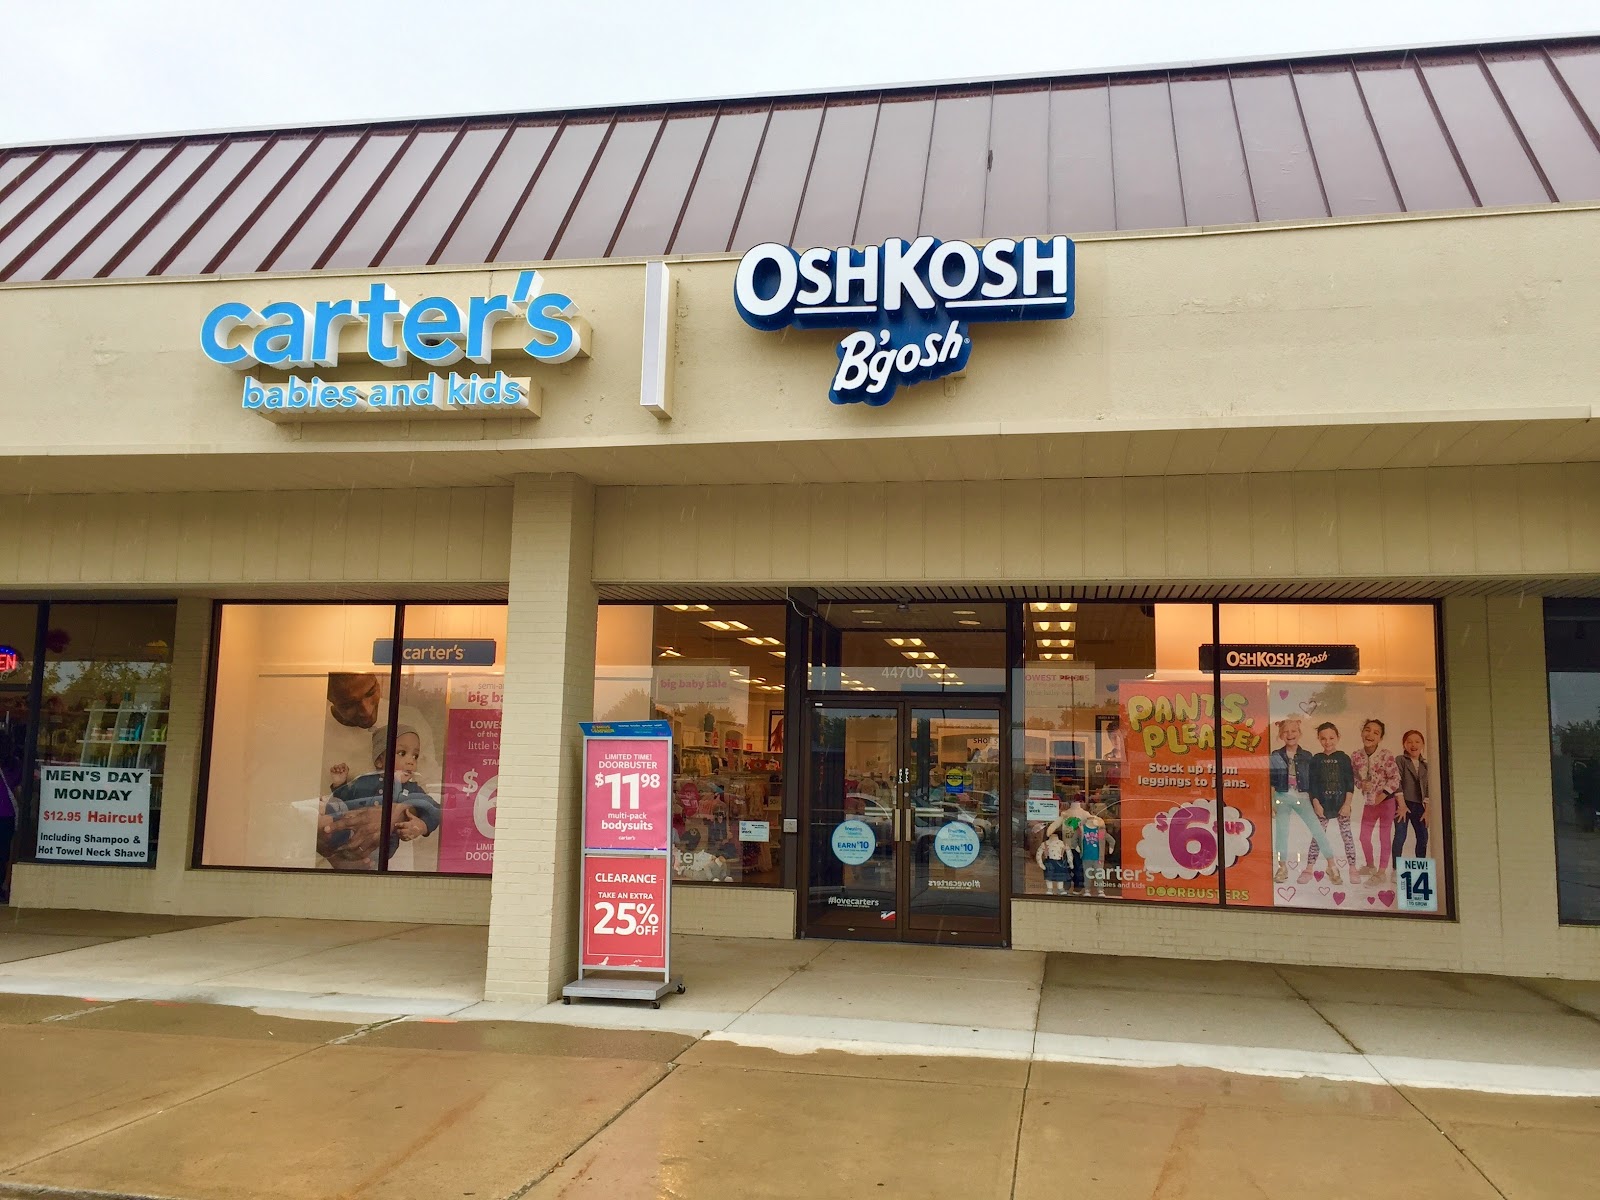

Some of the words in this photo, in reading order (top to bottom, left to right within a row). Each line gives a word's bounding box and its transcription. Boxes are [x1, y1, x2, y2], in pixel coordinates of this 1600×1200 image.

[735, 234, 1070, 316] OSHKOSH
[199, 269, 578, 367] carter's
[832, 319, 960, 394] B'gosh
[241, 375, 359, 409] babies
[367, 371, 436, 408] and
[448, 370, 524, 406] kids
[402, 643, 465, 660] carter's
[1226, 650, 1294, 668] OSHKOSH
[1295, 651, 1329, 669] B'gosh
[881, 666, 924, 680] 44700
[660, 679, 677, 690] big
[679, 679, 704, 690] baby
[705, 679, 727, 688] sale
[467, 691, 489, 706] big
[468, 741, 490, 750] little
[1142, 723, 1262, 758] PLEASE!
[633, 753, 653, 761] TIME!
[598, 761, 658, 769] DOORBUSTER
[1149, 762, 1184, 775] Stock
[1187, 764, 1203, 778] up
[45, 769, 102, 784] MEN'S
[107, 770, 144, 784] DAY
[1137, 775, 1191, 788] leggings
[1194, 776, 1208, 788] to
[1211, 776, 1250, 790] jans.
[53, 788, 133, 802] MONDAY
[43, 811, 82, 823] $12.95
[87, 811, 144, 824] Haircut
[607, 811, 647, 820] multi-pack
[601, 820, 654, 832] bodysuits
[1224, 820, 1246, 836] UP
[40, 832, 82, 846] Including
[83, 833, 130, 847] Shampoo
[132, 834, 141, 844] &
[37, 845, 55, 855] Hot
[56, 846, 83, 856] Towel
[86, 847, 112, 858] Neck
[113, 848, 146, 858] Shave
[1405, 860, 1428, 870] NEW!
[595, 872, 657, 884] CLEARANCE
[1084, 864, 1156, 882] carter's
[1093, 880, 1116, 888] babies
[1132, 881, 1146, 889] kids
[1400, 870, 1433, 901] 14
[597, 891, 616, 899] TAKE
[629, 892, 654, 900] EXTRA
[828, 896, 880, 907] #lovecarters
[593, 901, 660, 936] 25%
[635, 925, 659, 936] OFF
